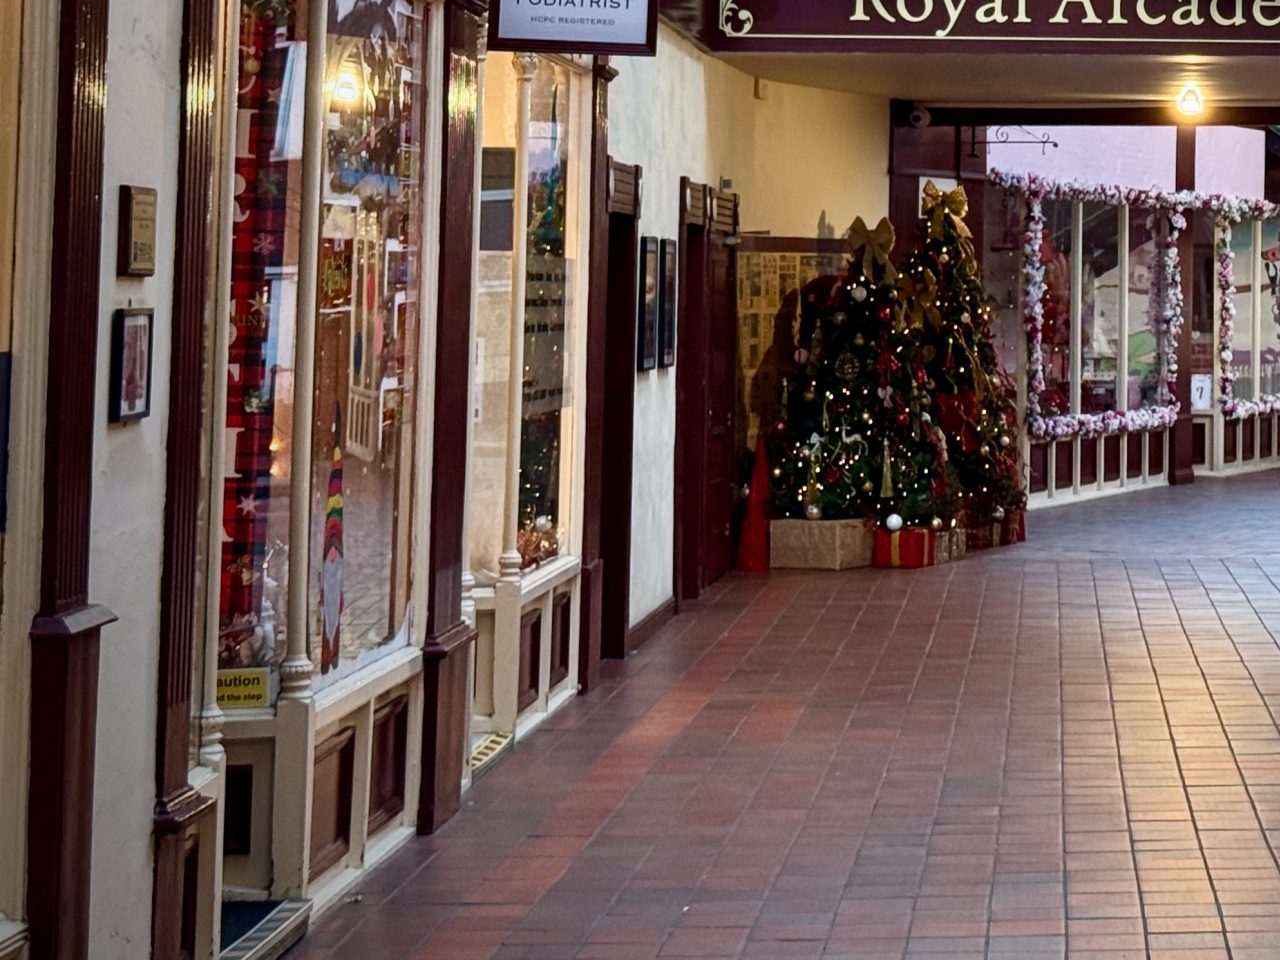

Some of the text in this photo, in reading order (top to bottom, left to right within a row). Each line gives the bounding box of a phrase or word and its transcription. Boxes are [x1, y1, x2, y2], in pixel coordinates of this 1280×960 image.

[530, 15, 616, 26] HCPC REGISTERED
[217, 675, 260, 688] aution
[226, 693, 242, 702] the
[243, 693, 262, 702] step
